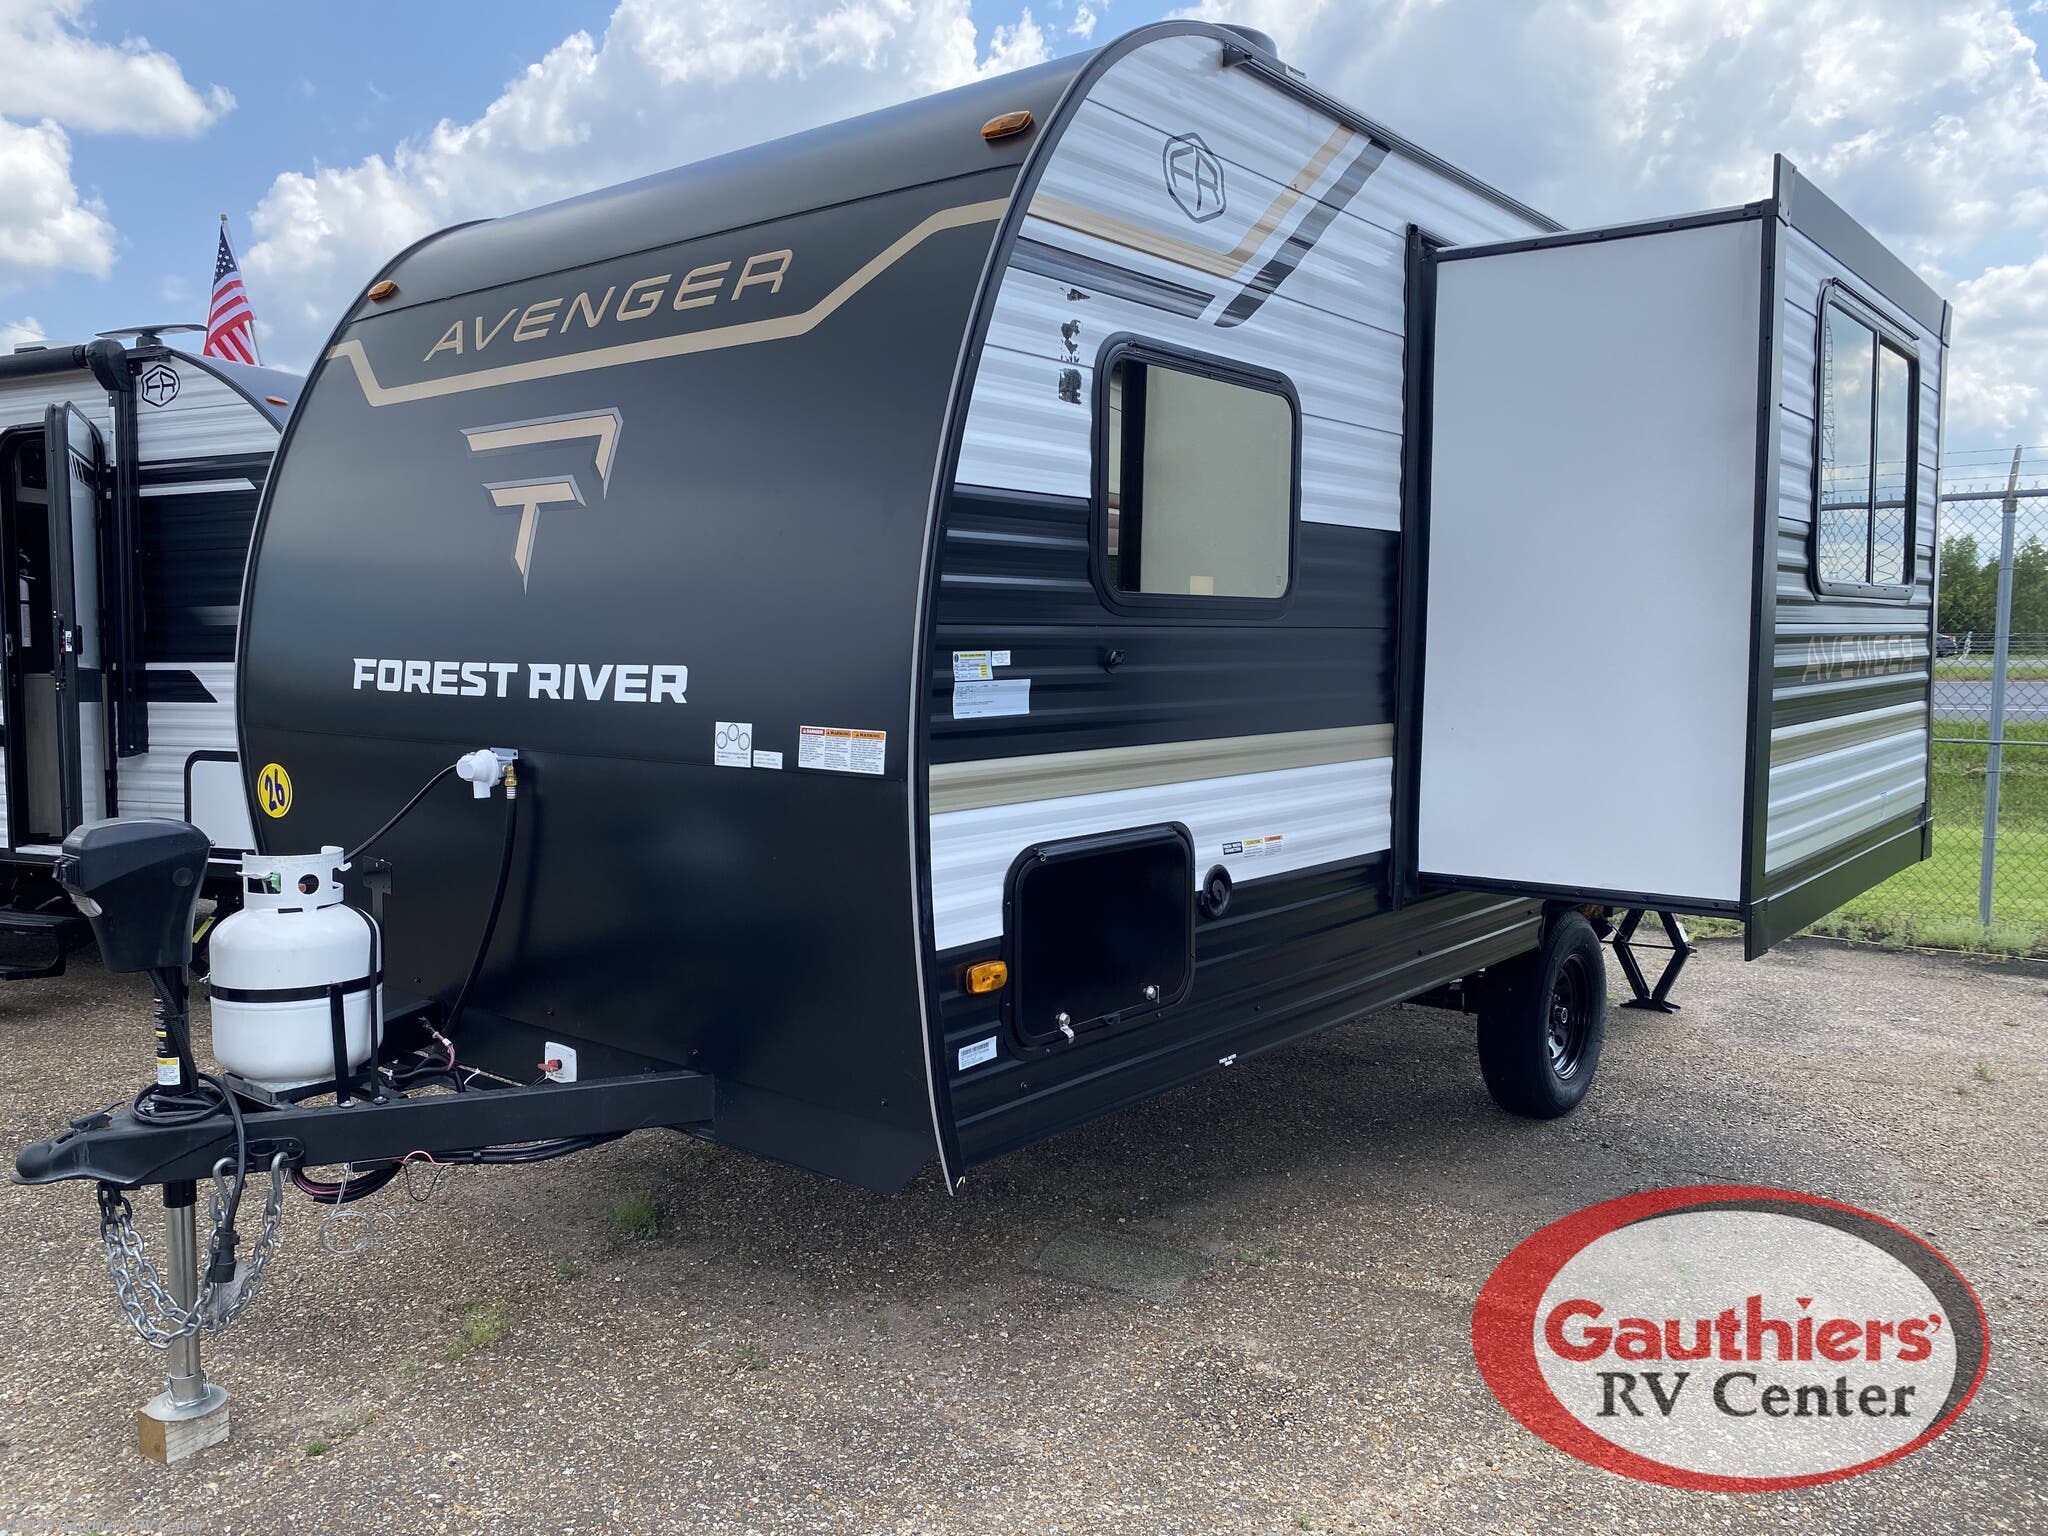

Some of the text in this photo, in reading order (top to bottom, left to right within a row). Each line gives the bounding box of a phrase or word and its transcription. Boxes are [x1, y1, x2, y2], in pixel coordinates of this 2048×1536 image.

[423, 248, 794, 362] AVENGER
[353, 657, 688, 704] FOREST RIVER
[1801, 634, 1912, 683] AVENGER
[264, 768, 285, 812] 26
